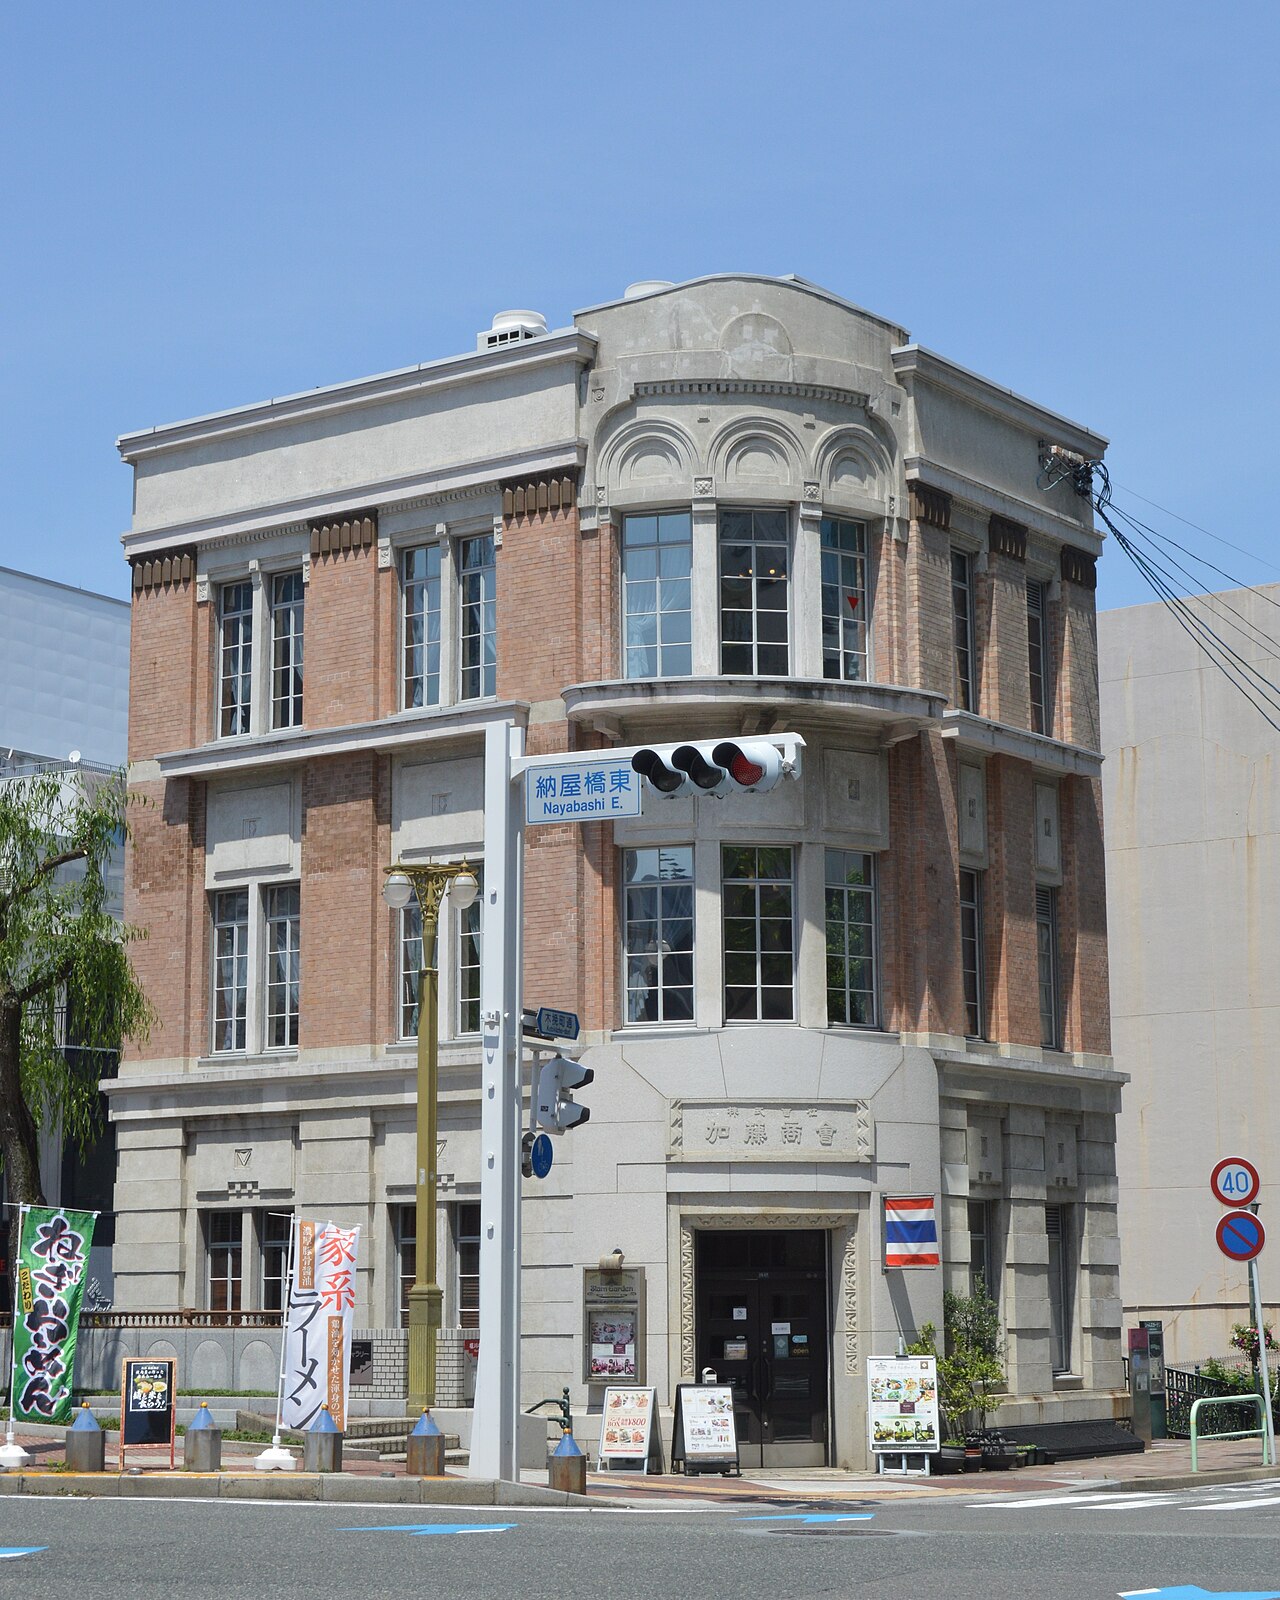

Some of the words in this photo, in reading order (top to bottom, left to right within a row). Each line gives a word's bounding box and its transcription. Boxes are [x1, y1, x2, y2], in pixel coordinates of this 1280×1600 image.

[536, 769, 632, 799] 納屋橋東
[543, 798, 605, 815] Nayabashi
[611, 797, 623, 809] E.
[705, 1122, 838, 1146] 加藤商會
[1222, 1171, 1249, 1193] 40
[319, 1228, 356, 1311] 家系
[21, 1271, 32, 1310] こだわり
[286, 1291, 322, 1430] ラーメン
